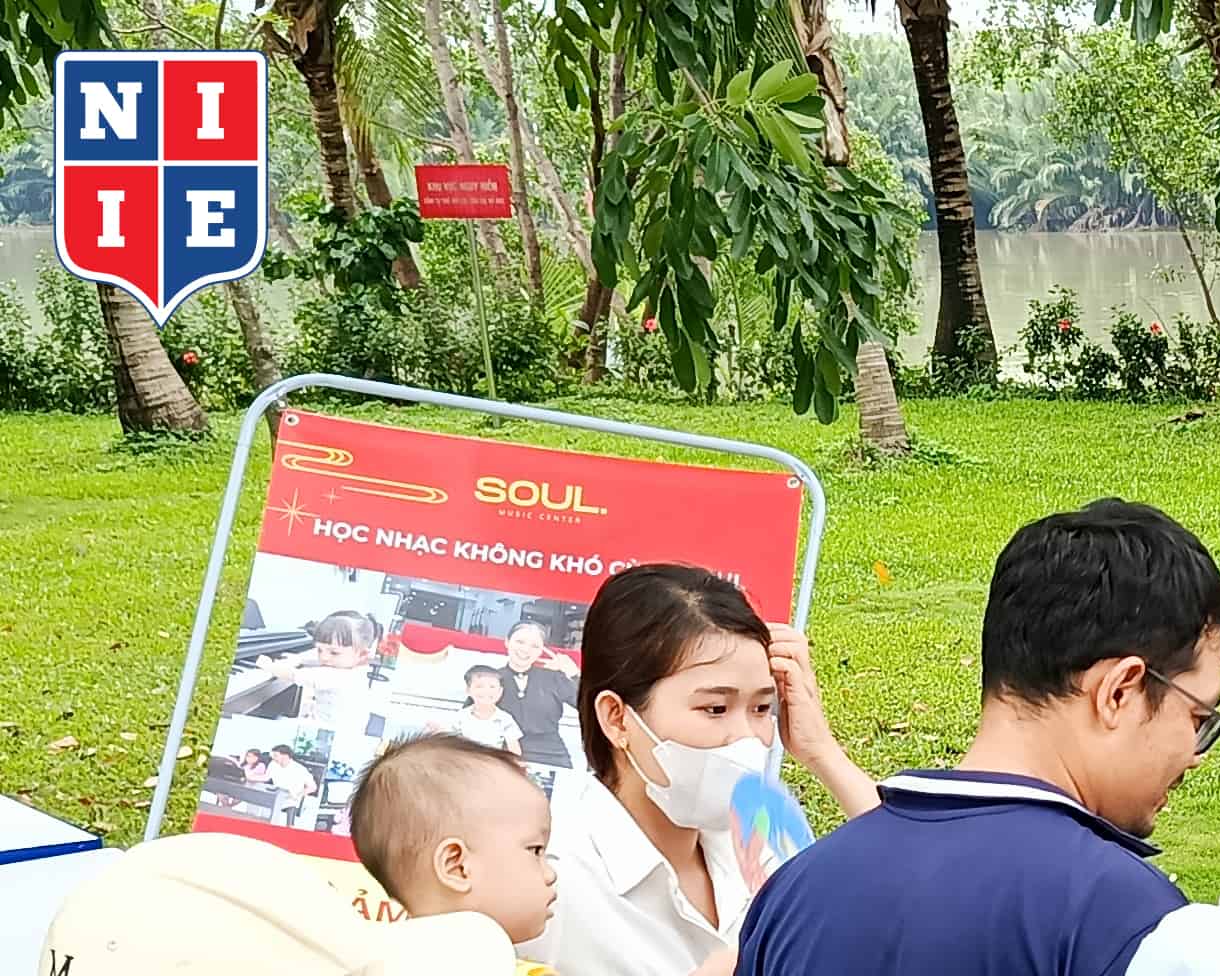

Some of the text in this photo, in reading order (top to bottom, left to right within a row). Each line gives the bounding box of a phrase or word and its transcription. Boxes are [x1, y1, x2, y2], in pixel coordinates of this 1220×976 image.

[498, 508, 581, 524] MUSIC CENTER
[313, 518, 370, 543] HỌC
[375, 527, 448, 556] NHẠC
[453, 541, 544, 569] KHÔNG
[549, 552, 603, 575] KHÓ
